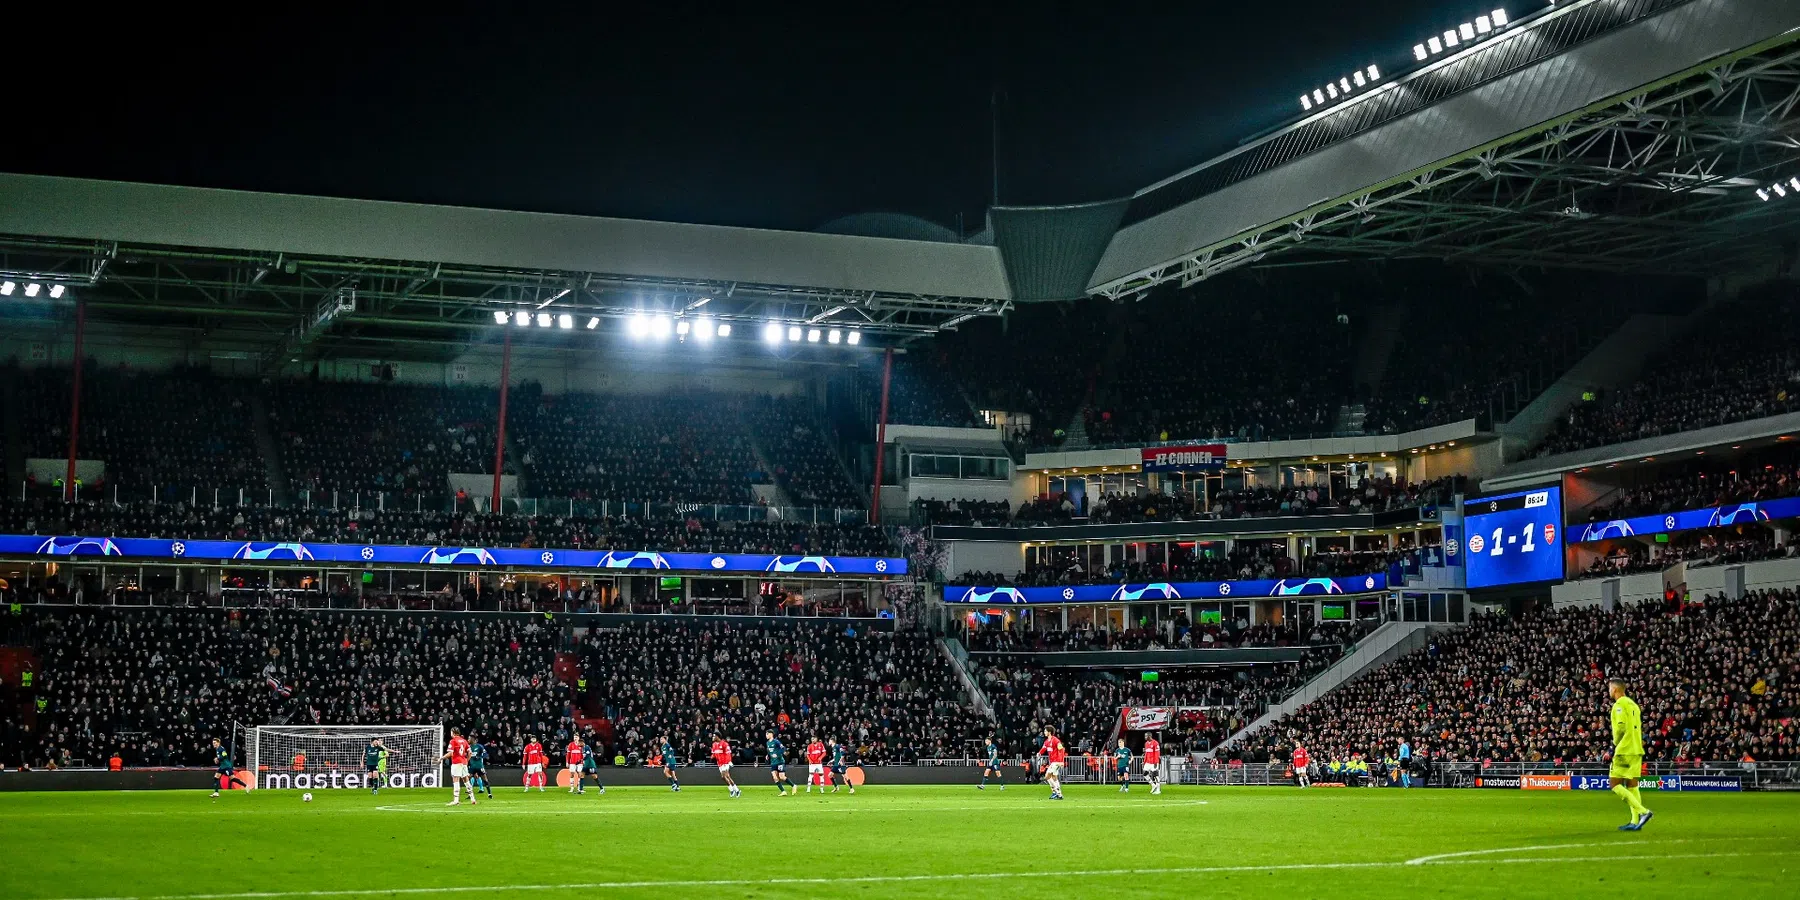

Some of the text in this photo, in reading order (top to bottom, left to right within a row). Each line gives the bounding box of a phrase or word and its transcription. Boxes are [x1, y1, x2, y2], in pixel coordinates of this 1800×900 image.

[1169, 452, 1212, 465] CORNER
[1140, 713, 1157, 722] PSV
[265, 769, 438, 789] masterard
[1483, 777, 1521, 787] mastercard
[1720, 780, 1738, 788] LEAGUE
